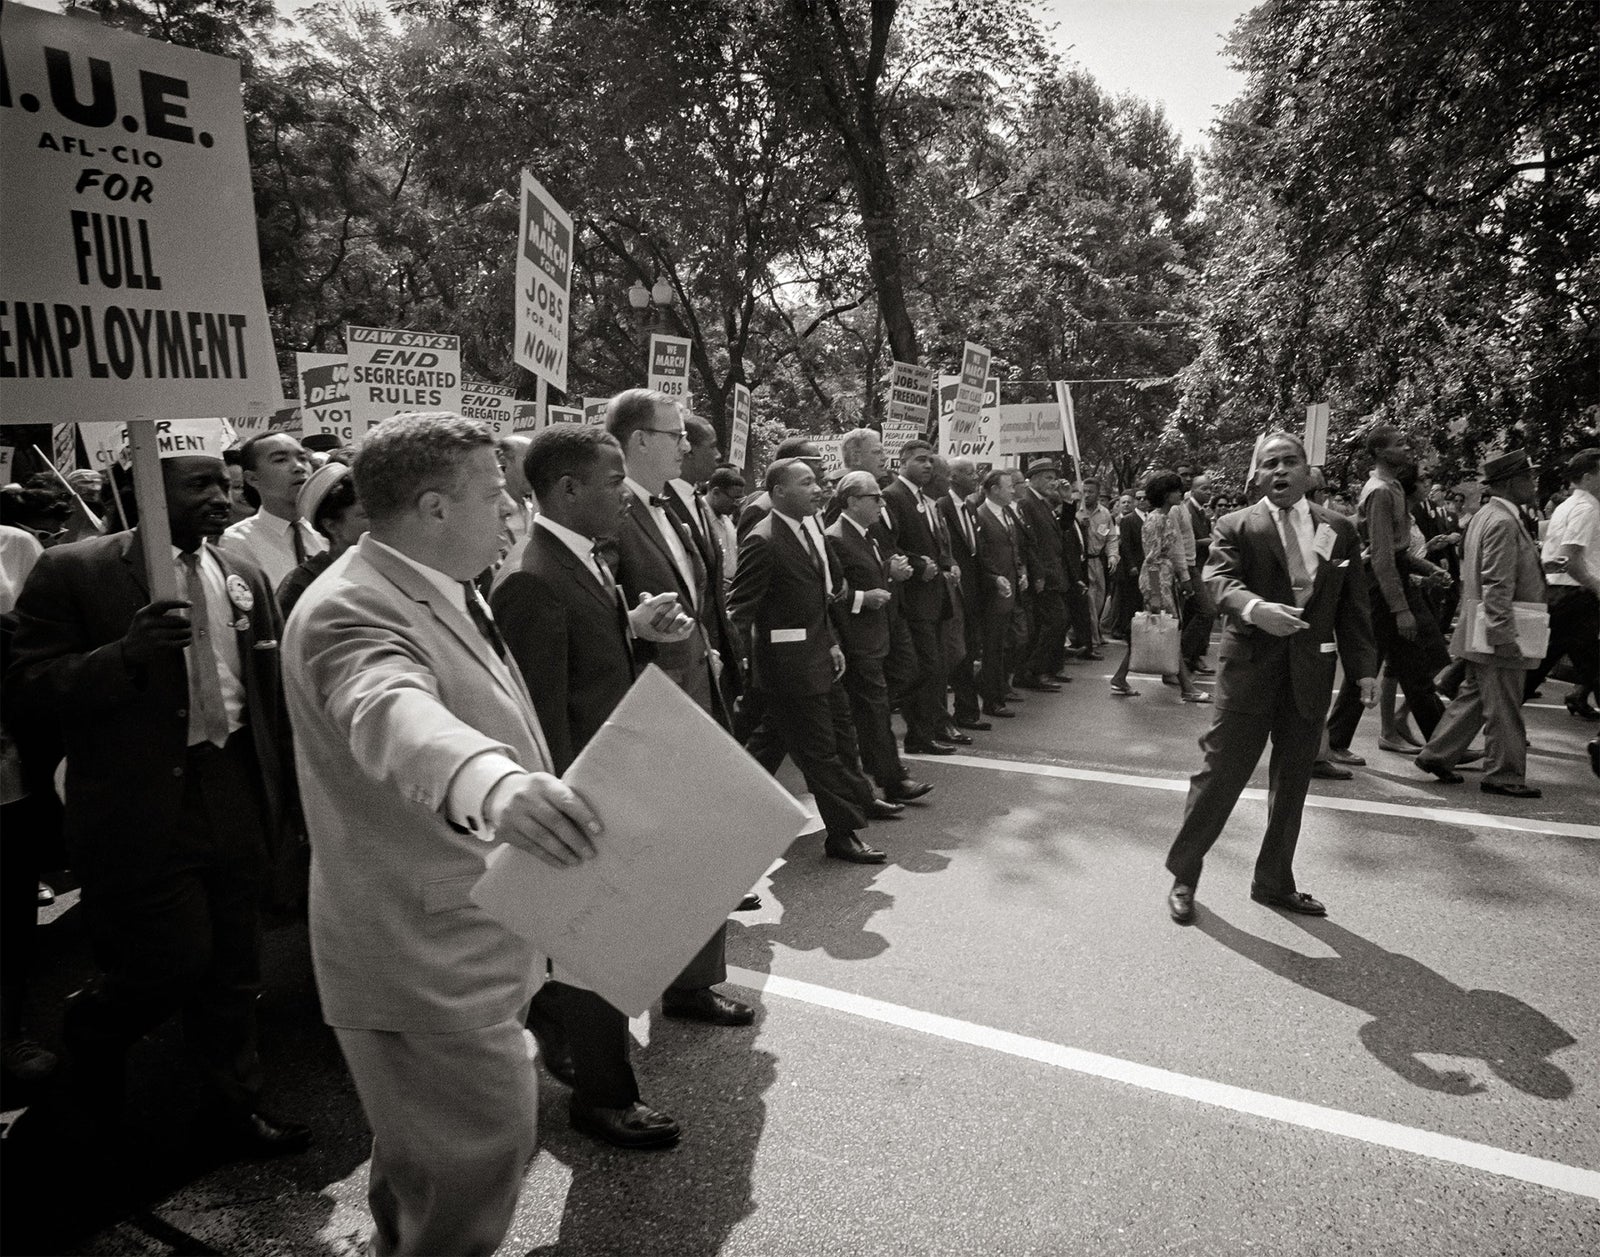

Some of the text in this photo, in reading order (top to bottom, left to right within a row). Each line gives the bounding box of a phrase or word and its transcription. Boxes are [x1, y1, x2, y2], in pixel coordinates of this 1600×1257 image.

[38, 132, 163, 169] AFL-CIO
[75, 168, 153, 204] FOR
[543, 210, 557, 238] WE
[71, 209, 162, 290] FULL
[528, 220, 567, 273] MARCH
[541, 256, 556, 277] FOR
[525, 277, 563, 324] JOBS
[527, 307, 561, 342] FOR ALL
[0, 301, 247, 380] EMPLOYMENT
[354, 329, 456, 350] UAW SAYS:
[667, 345, 677, 355] WE
[369, 349, 440, 368] END
[524, 331, 563, 375] NOW!
[655, 355, 685, 368] MARCH
[331, 367, 350, 383] W
[353, 366, 456, 389] SEGREGATED
[309, 381, 350, 404] DEM
[369, 387, 442, 406] RULES
[461, 395, 502, 409] END
[893, 390, 928, 406] FREEDOM
[314, 410, 351, 423] VOT
[461, 406, 511, 422] GREGATED
[563, 414, 574, 422] WE
[953, 420, 976, 434] NOW!
